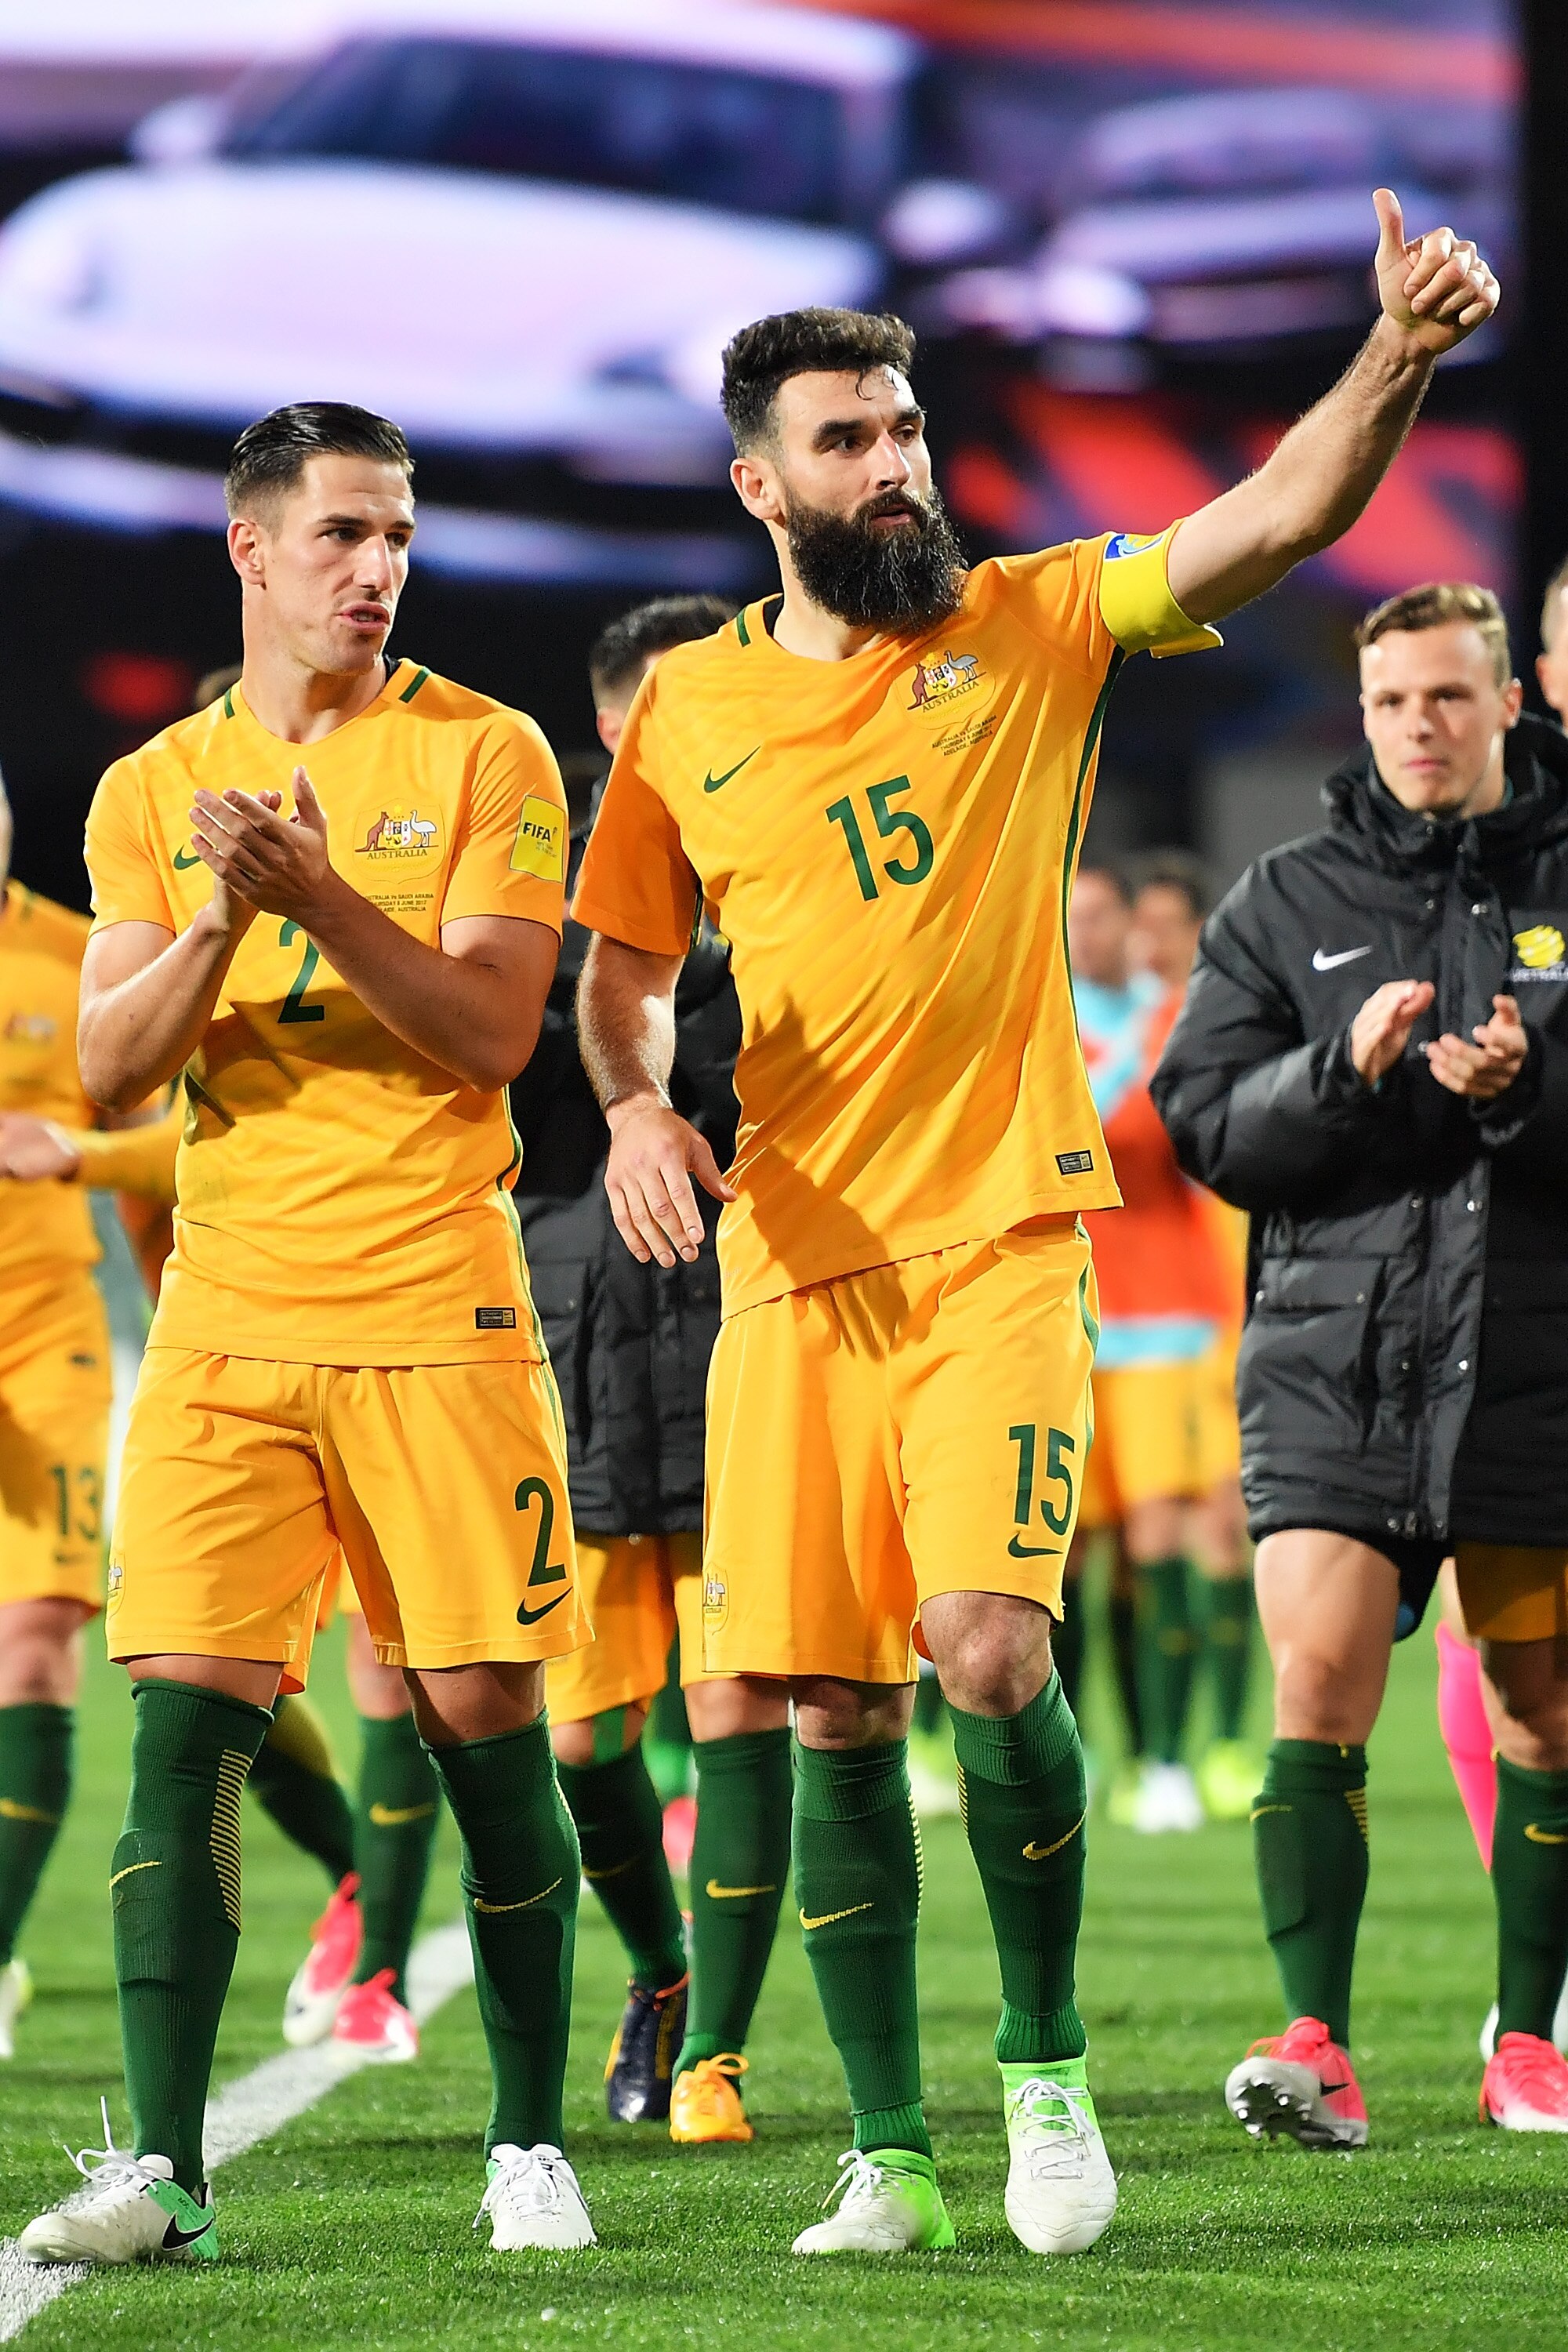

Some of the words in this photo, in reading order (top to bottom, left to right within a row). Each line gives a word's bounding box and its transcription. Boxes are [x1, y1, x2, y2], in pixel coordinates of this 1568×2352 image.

[922, 681, 979, 713] AUSTRALIA
[366, 848, 428, 860] AUSTRALIA
[522, 822, 551, 843] FIFA
[826, 775, 934, 902] 15
[278, 919, 325, 1023] 2
[48, 1465, 100, 1541] 13
[1009, 1424, 1075, 1536] 15
[515, 1476, 567, 1588] 2
